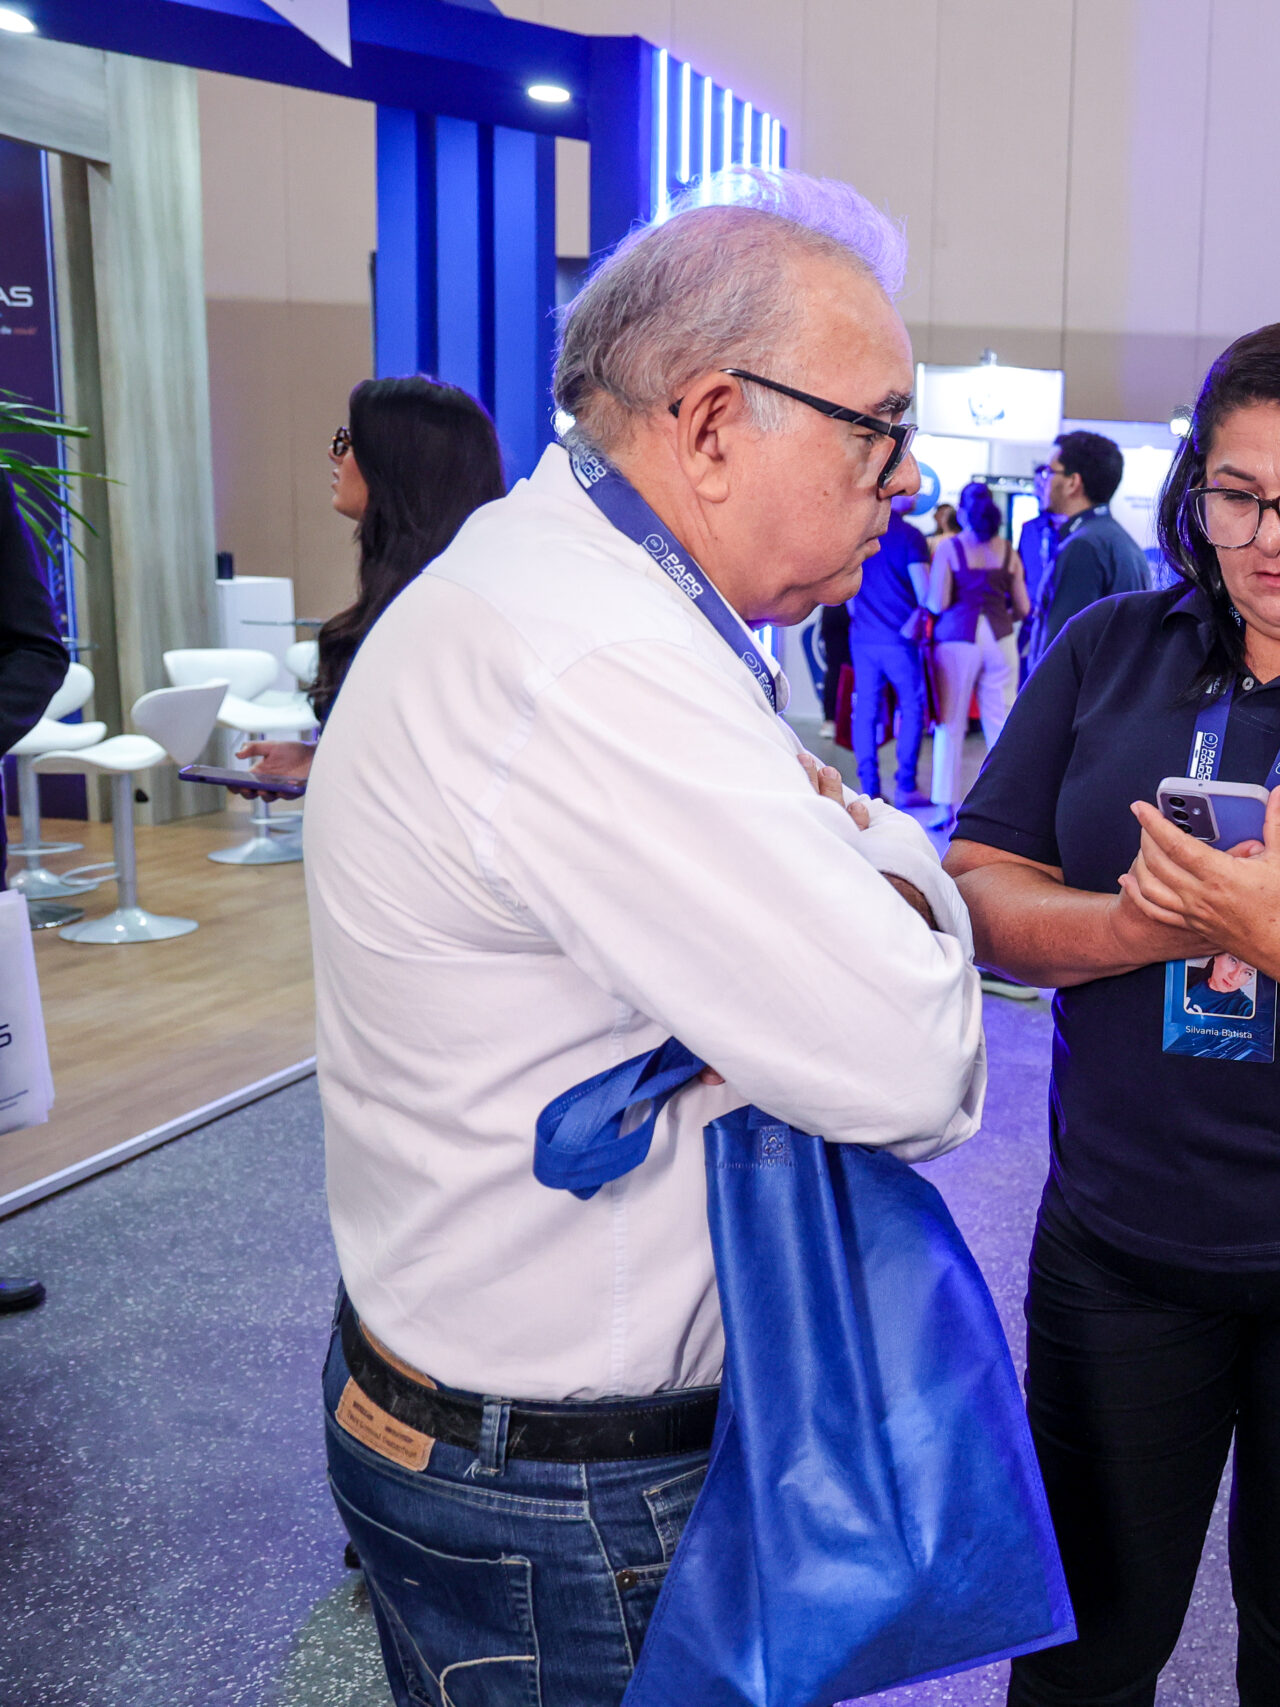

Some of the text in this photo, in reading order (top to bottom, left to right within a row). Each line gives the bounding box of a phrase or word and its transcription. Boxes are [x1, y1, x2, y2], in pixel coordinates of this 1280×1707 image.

[661, 559, 697, 600] CONDO
[667, 552, 704, 595] PAPO
[1197, 748, 1208, 780] CONDO
[1203, 750, 1216, 781] PAPO
[1185, 1025, 1253, 1039] Silvania Batista
